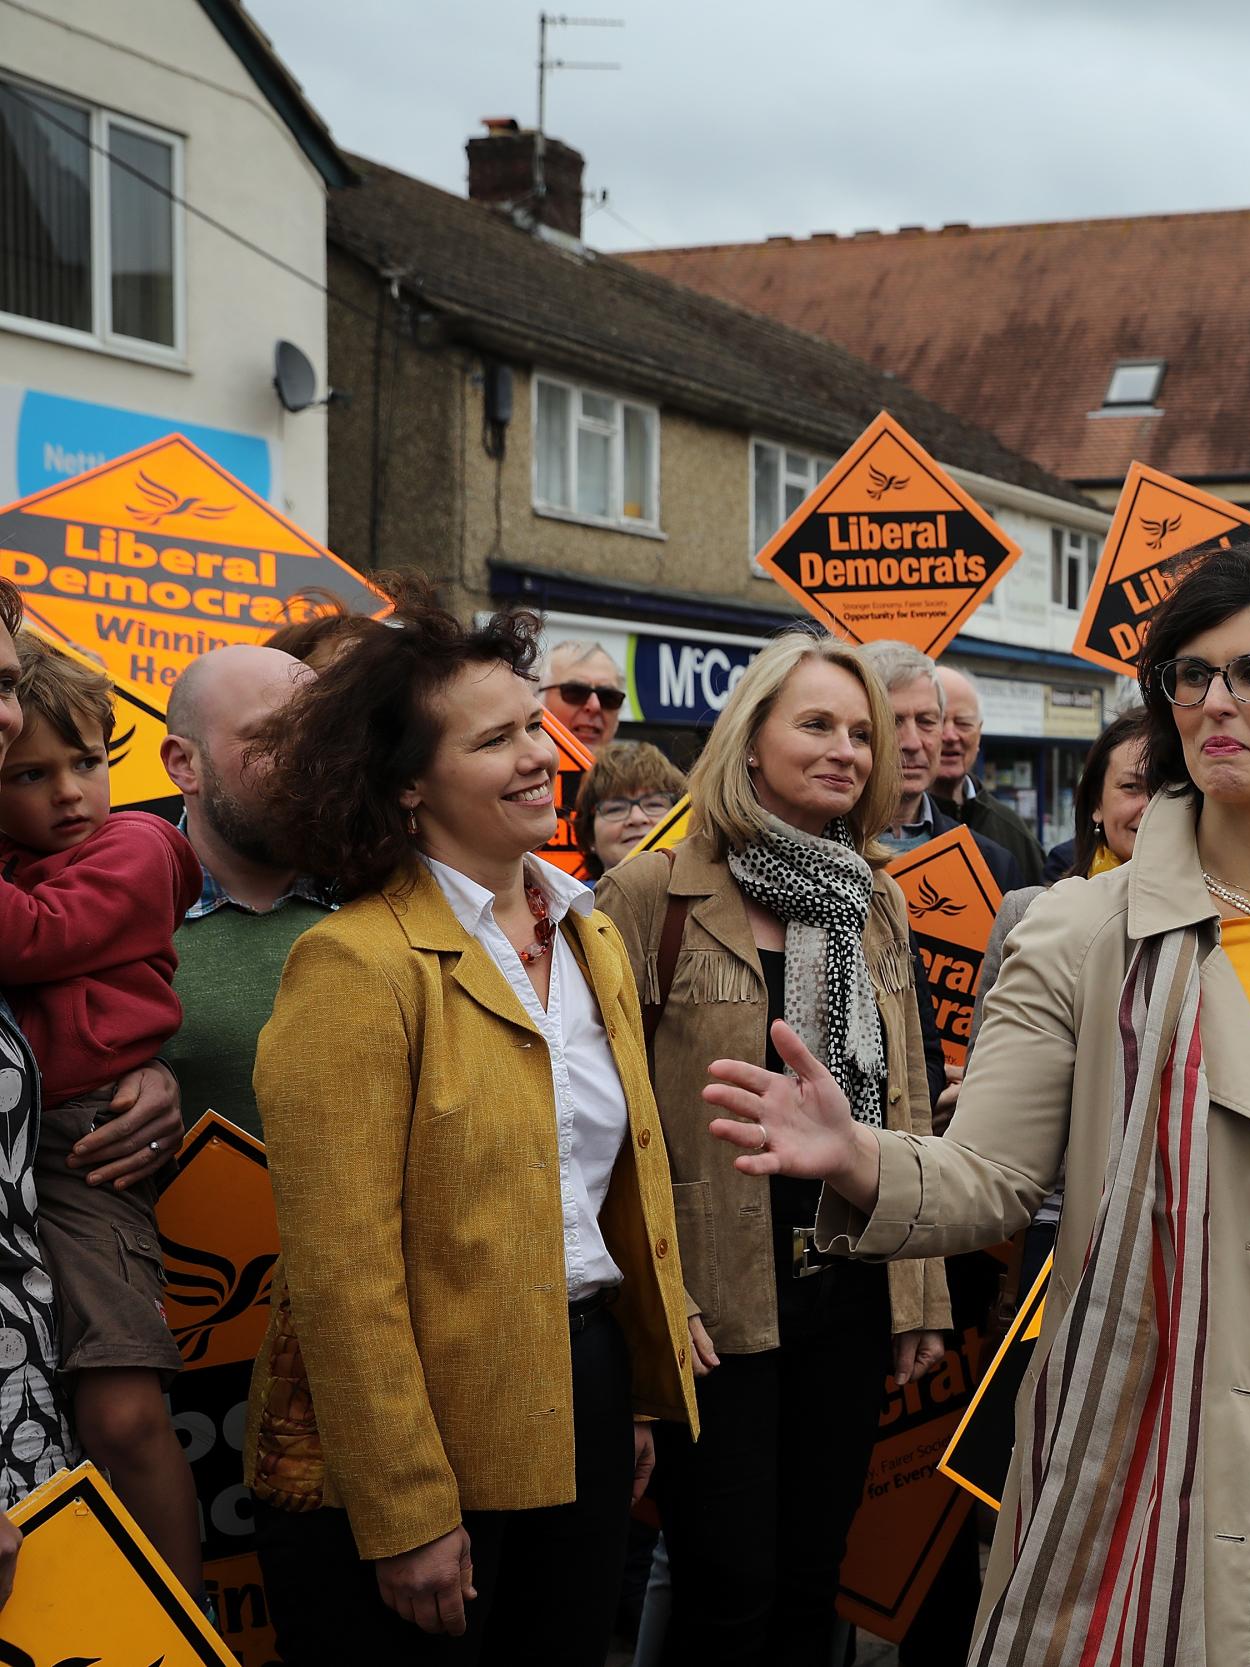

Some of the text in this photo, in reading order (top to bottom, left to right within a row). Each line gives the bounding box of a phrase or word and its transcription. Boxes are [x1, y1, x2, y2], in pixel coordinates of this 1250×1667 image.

[827, 513, 949, 552] Liberal
[64, 522, 278, 588] Liberal
[799, 548, 988, 588] Democrats
[95, 613, 253, 655] Winnin
[893, 1461, 939, 1489] Every
